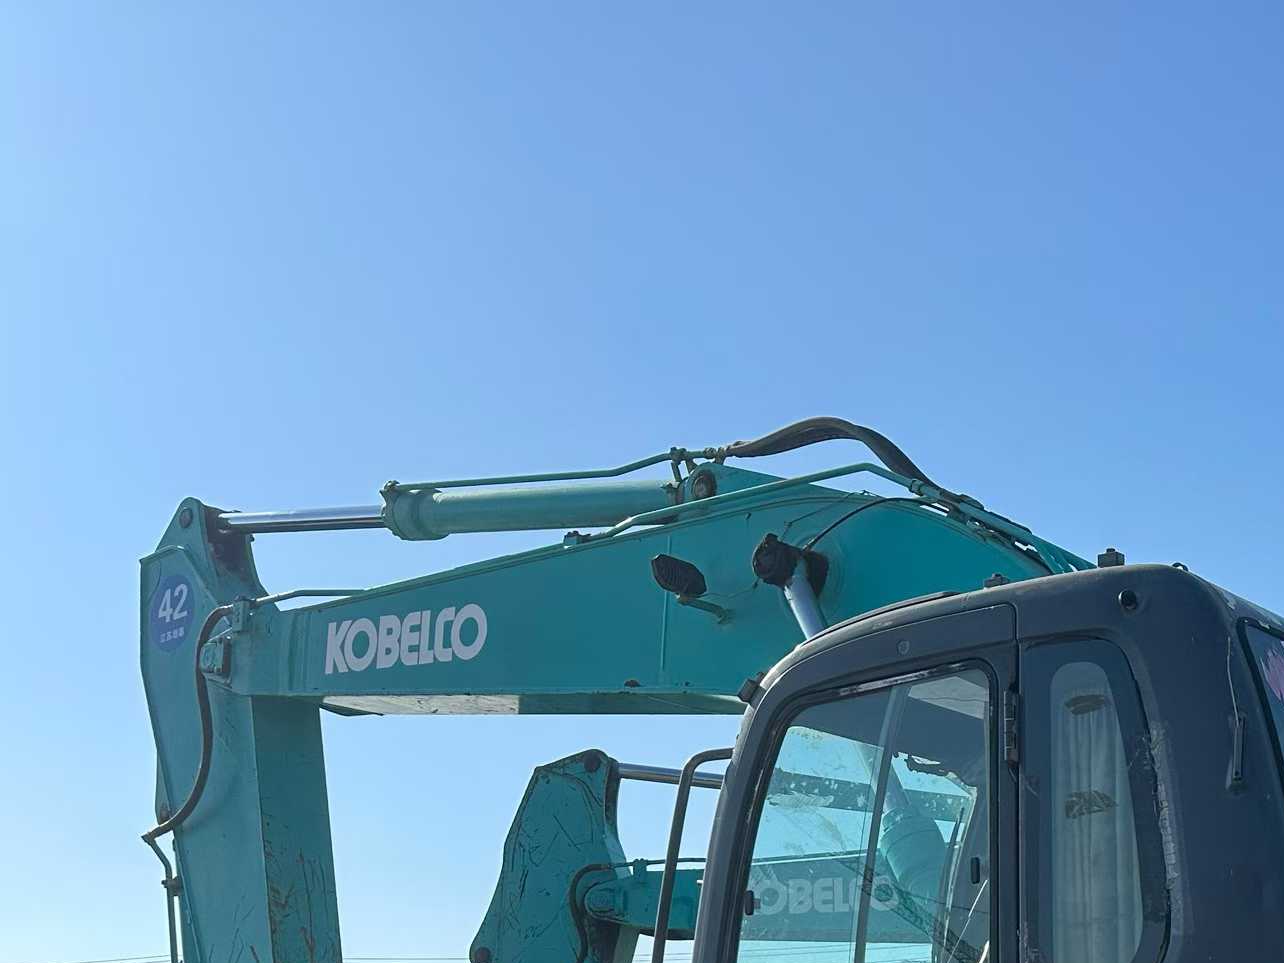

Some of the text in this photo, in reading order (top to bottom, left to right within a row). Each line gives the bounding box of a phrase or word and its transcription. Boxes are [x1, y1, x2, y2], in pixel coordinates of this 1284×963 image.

[158, 583, 188, 623] 42
[325, 603, 488, 675] KOBELCO
[742, 874, 899, 916] OBELO
